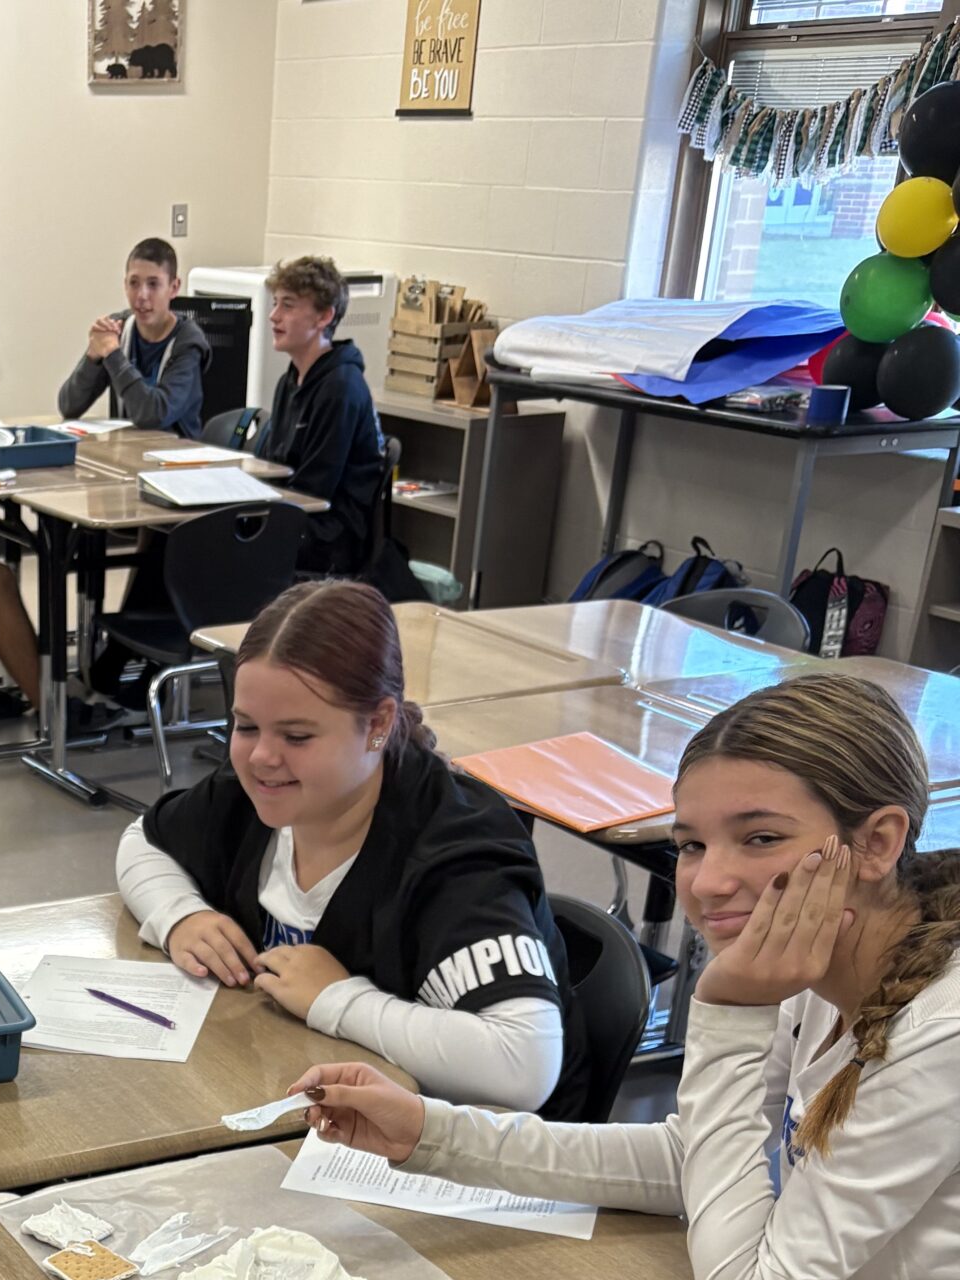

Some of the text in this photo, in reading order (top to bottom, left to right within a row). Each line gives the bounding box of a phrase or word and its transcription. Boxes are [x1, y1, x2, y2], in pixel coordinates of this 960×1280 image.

[436, 0, 469, 40] free
[413, 37, 465, 65] BE BRAVE
[409, 67, 459, 100] BE YOU
